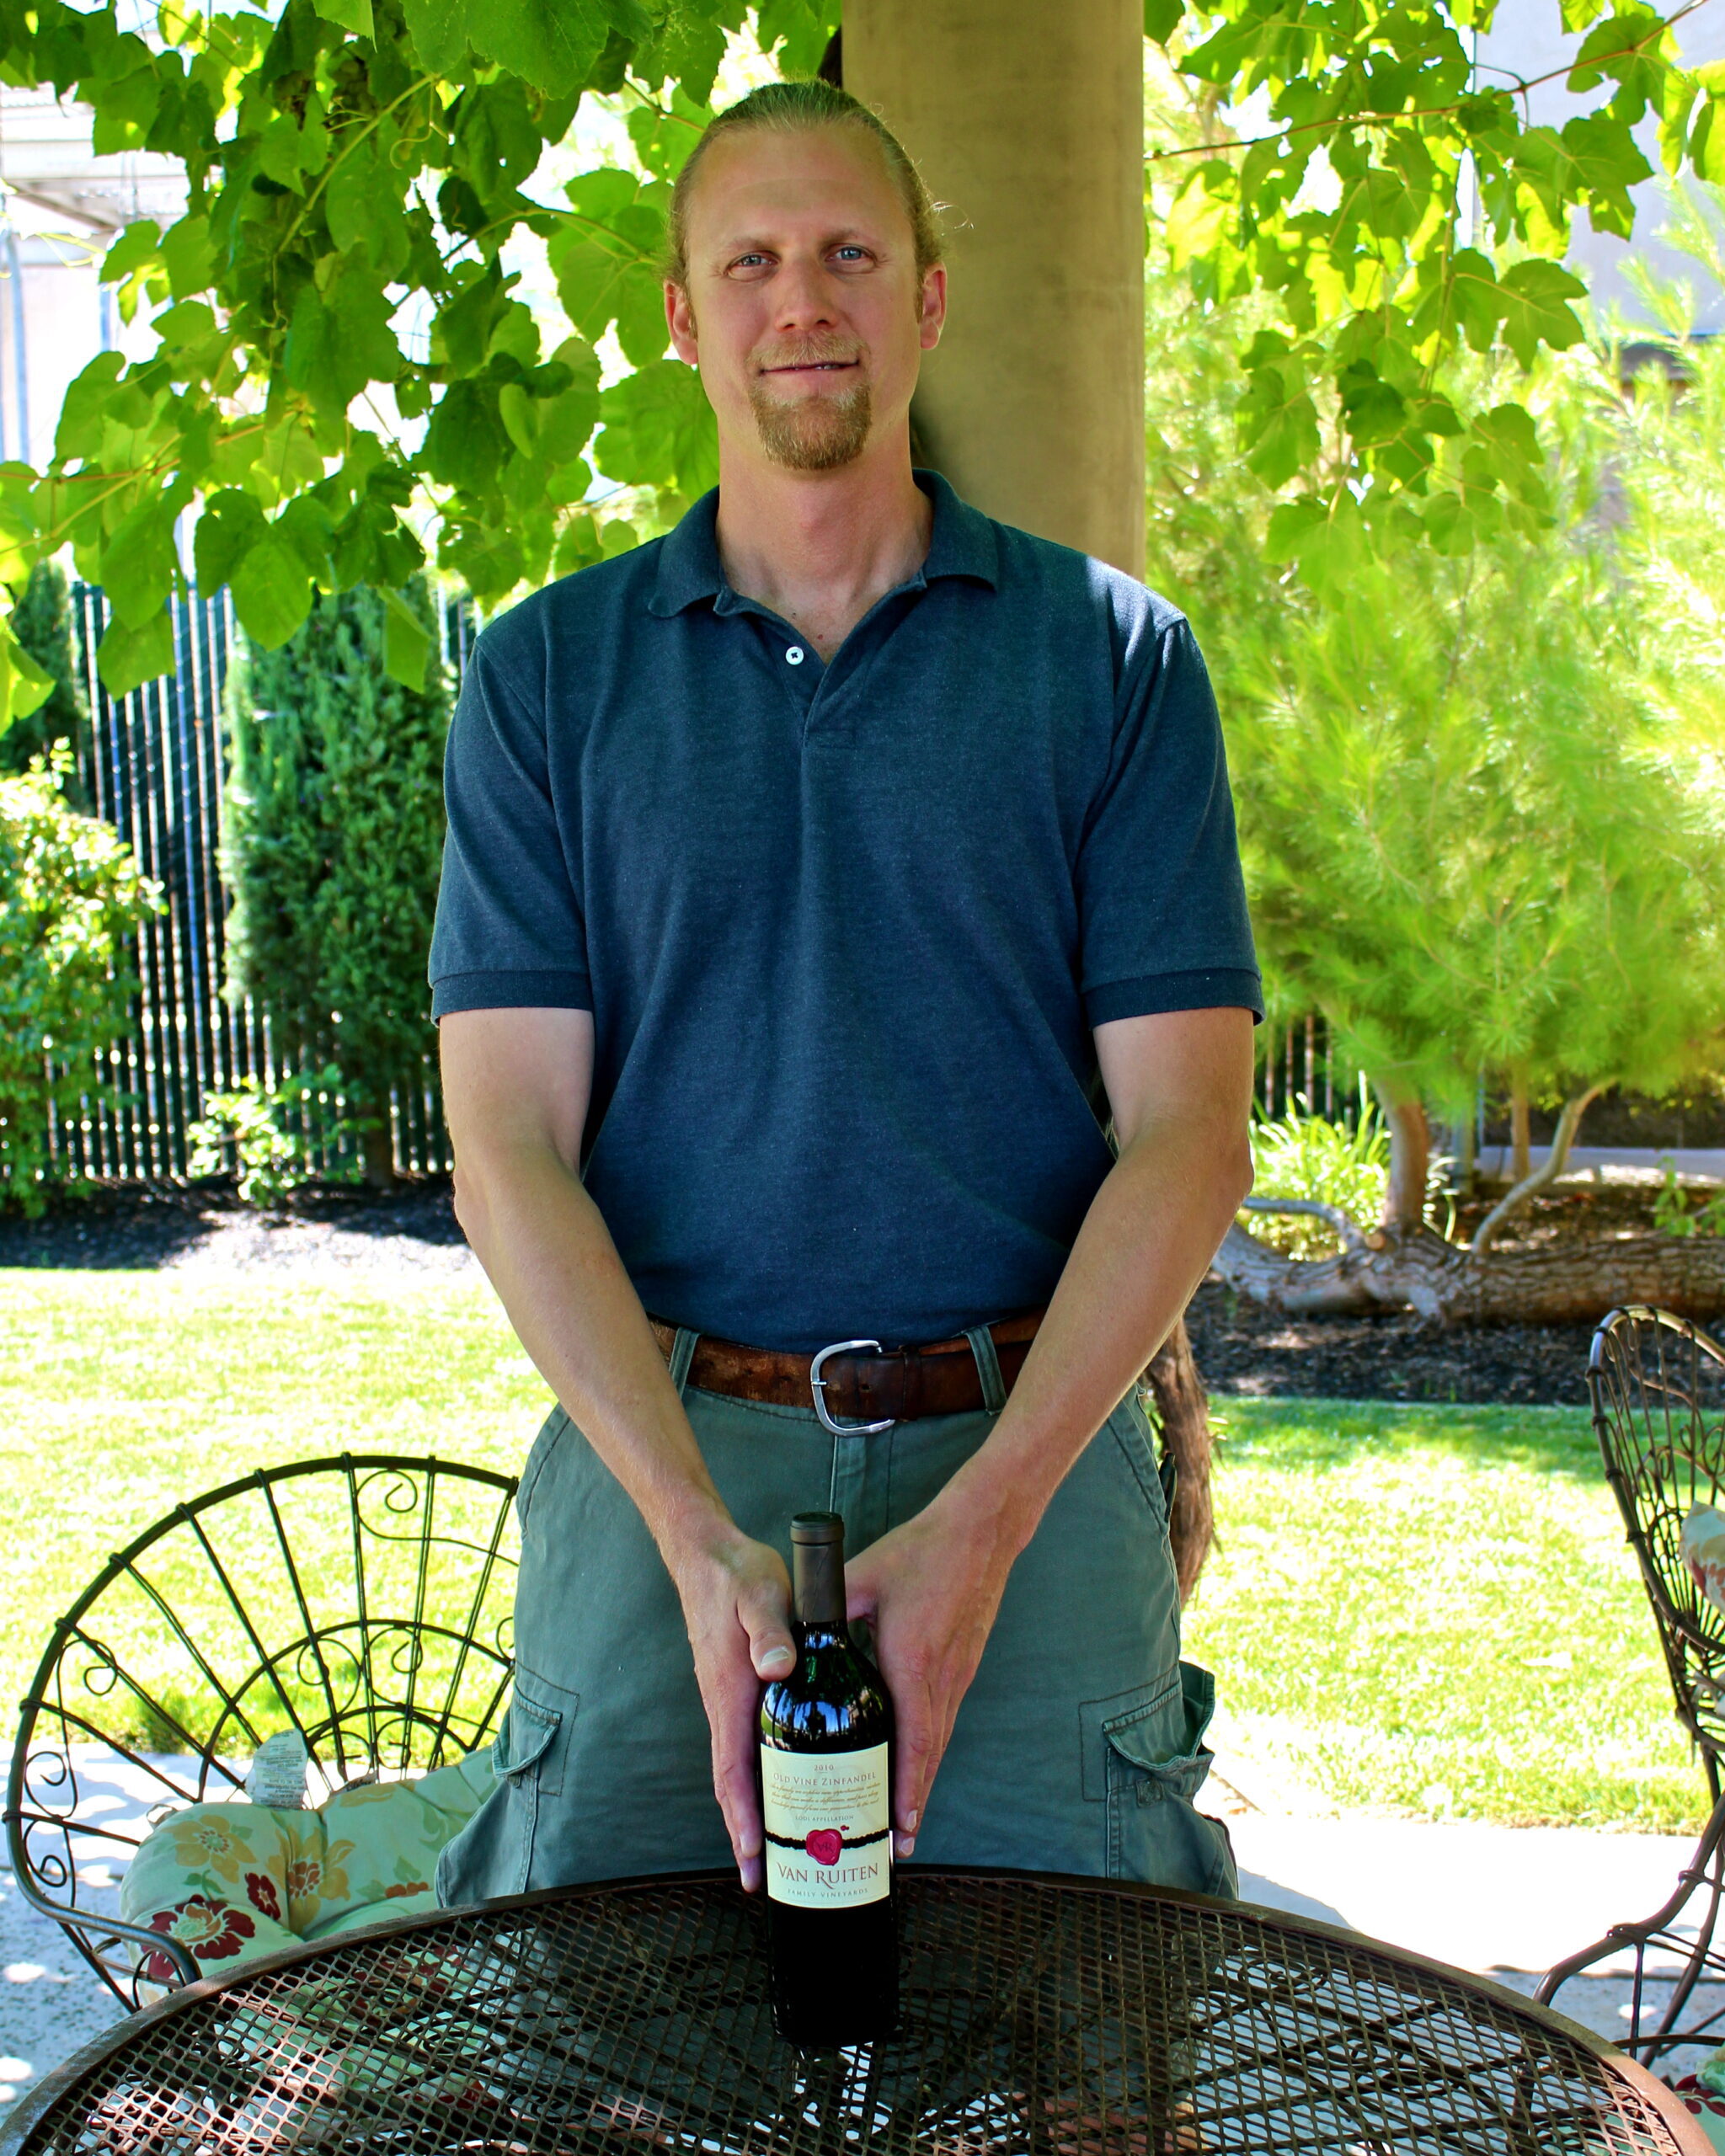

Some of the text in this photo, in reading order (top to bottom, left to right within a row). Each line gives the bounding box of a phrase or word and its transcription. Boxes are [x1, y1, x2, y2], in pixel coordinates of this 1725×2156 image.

[773, 1772, 876, 1786] OLD VINE ZINFANDEL
[776, 1861, 879, 1890] VAN RUITEN
[788, 1887, 868, 1897] FAMILY VINEYARDS
